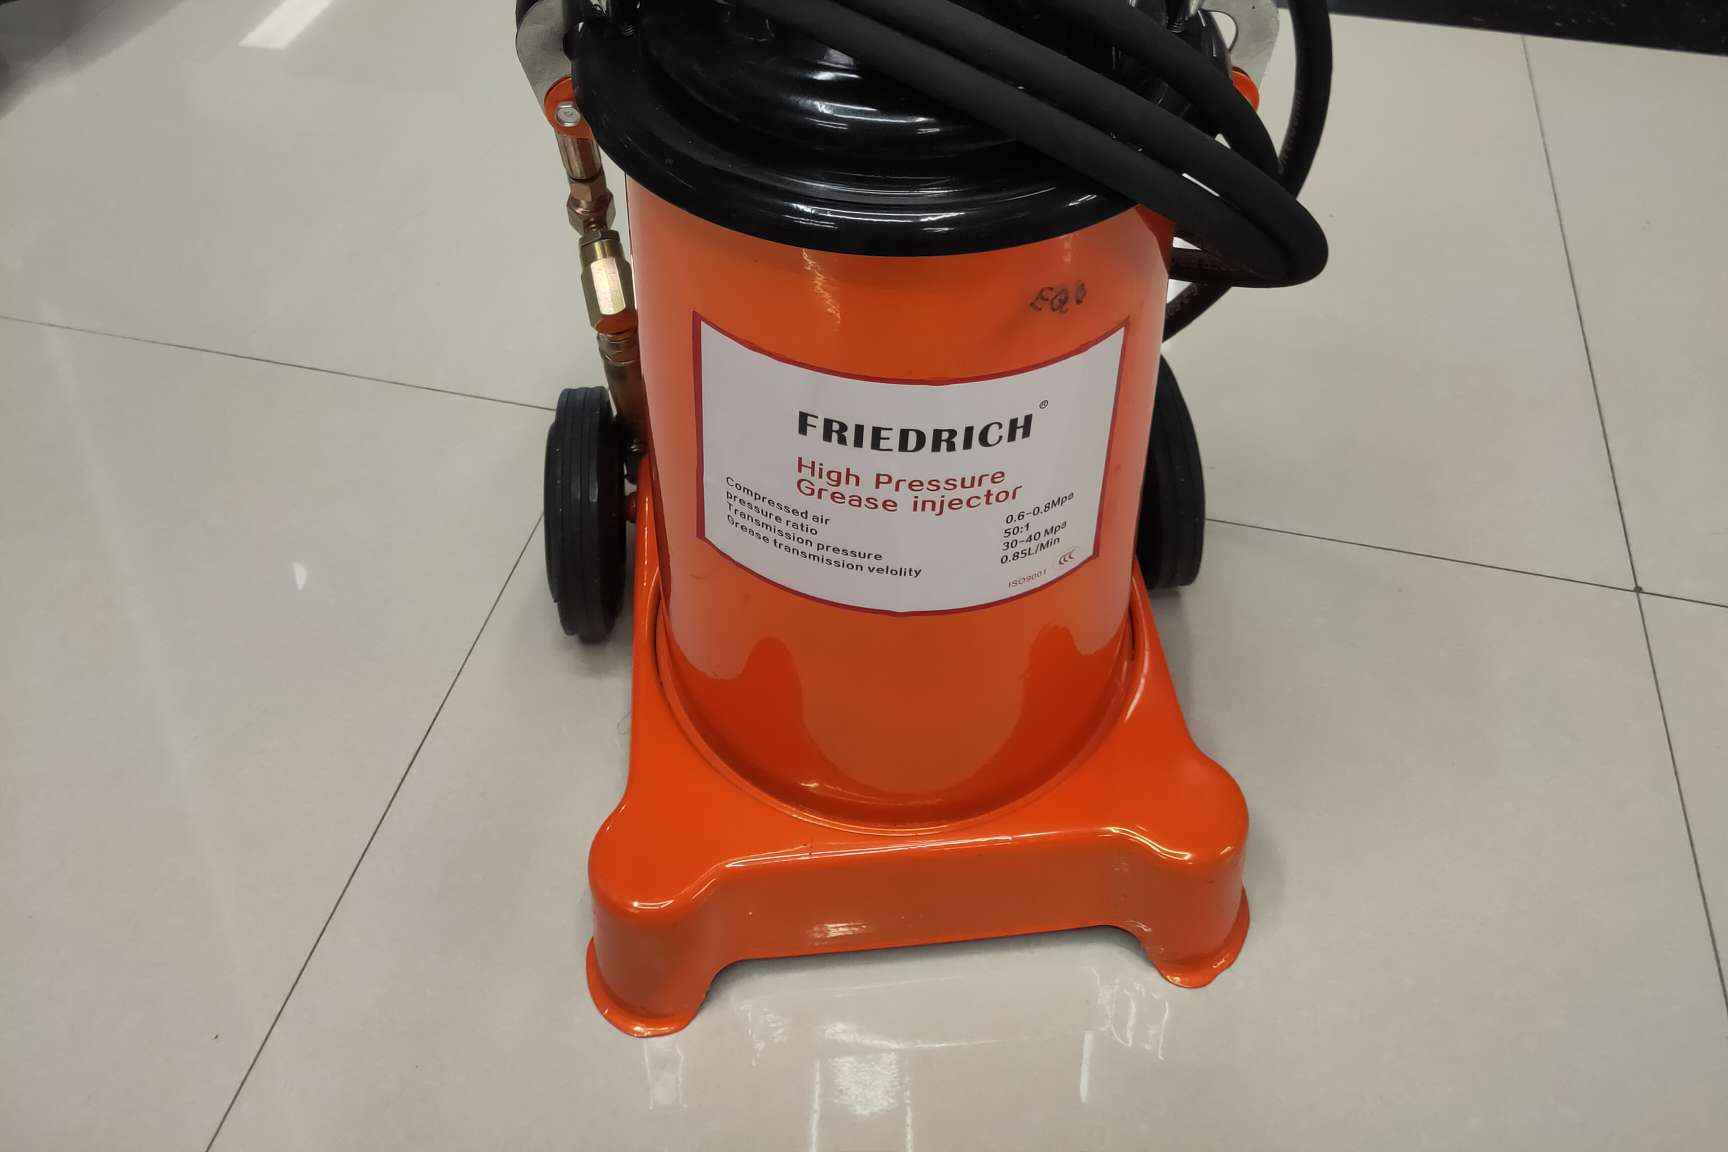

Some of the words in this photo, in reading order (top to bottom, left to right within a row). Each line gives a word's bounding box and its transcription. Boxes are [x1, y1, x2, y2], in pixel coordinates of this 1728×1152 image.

[798, 411, 1034, 453] FRIEDRICH
[797, 456, 861, 488] High
[875, 469, 1006, 493] Pressure
[726, 476, 809, 520] Compressed
[811, 514, 831, 526] air
[726, 490, 783, 524] pressure
[785, 518, 818, 536] ratio
[797, 478, 898, 512] Grease
[912, 484, 1023, 516] injector
[726, 501, 813, 548] Transmission
[816, 541, 883, 561] pressure
[727, 514, 770, 544] Grease
[773, 538, 864, 572] transmission
[867, 563, 922, 578] velolity
[1002, 531, 1041, 552] 30-40
[1043, 520, 1067, 538] Mpa
[1003, 522, 1030, 538] 50:1
[1000, 536, 1061, 565] 0.85L/Min
